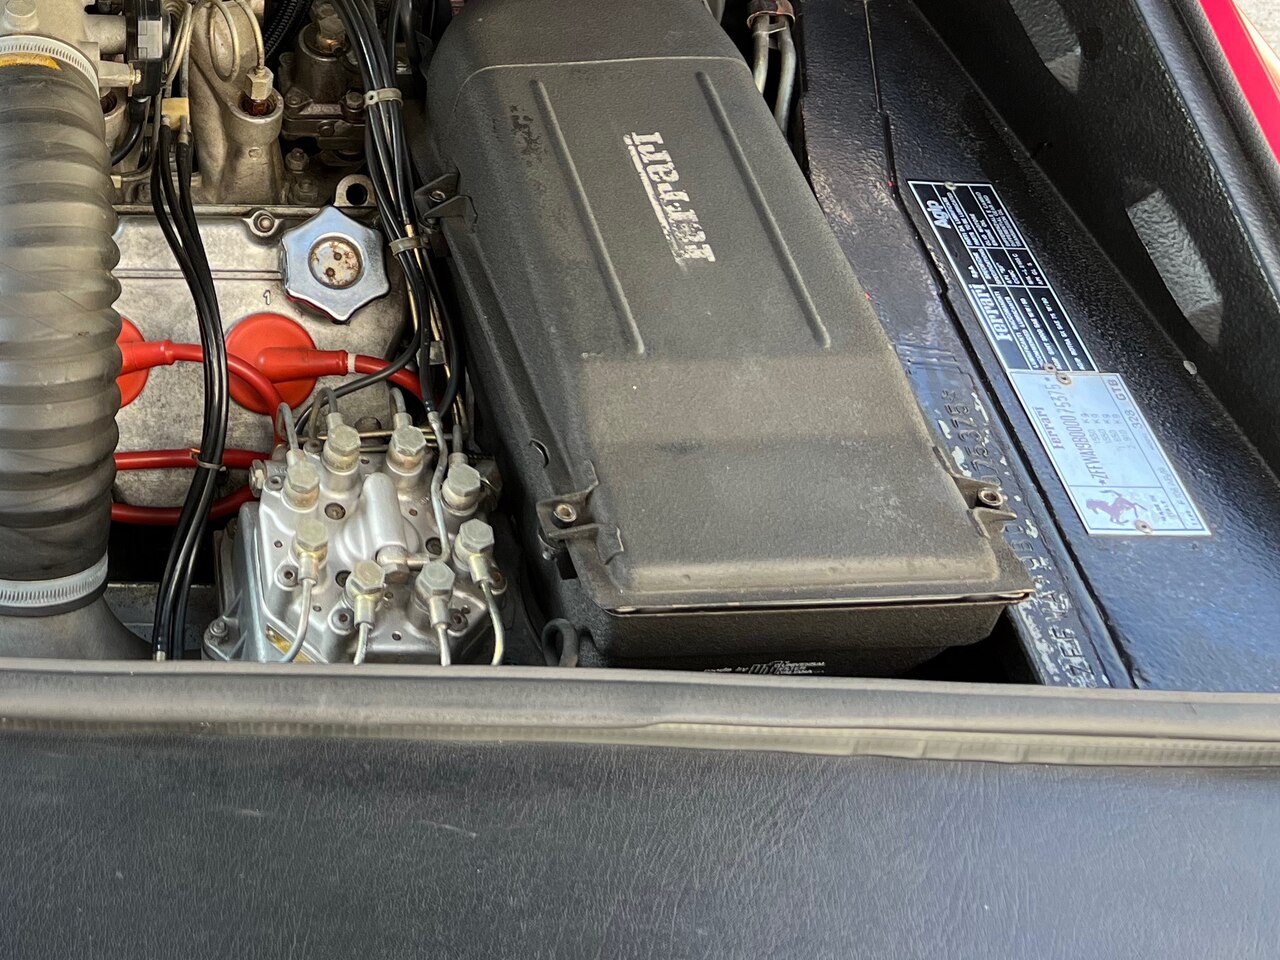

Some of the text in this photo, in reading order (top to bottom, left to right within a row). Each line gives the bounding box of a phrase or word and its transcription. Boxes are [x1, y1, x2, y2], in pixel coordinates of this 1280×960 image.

[926, 199, 952, 228] Agip
[967, 283, 1014, 340] Ferrari
[1106, 378, 1128, 400] GTB
[1031, 406, 1065, 449] Ferrari
[1124, 409, 1144, 428] 328
